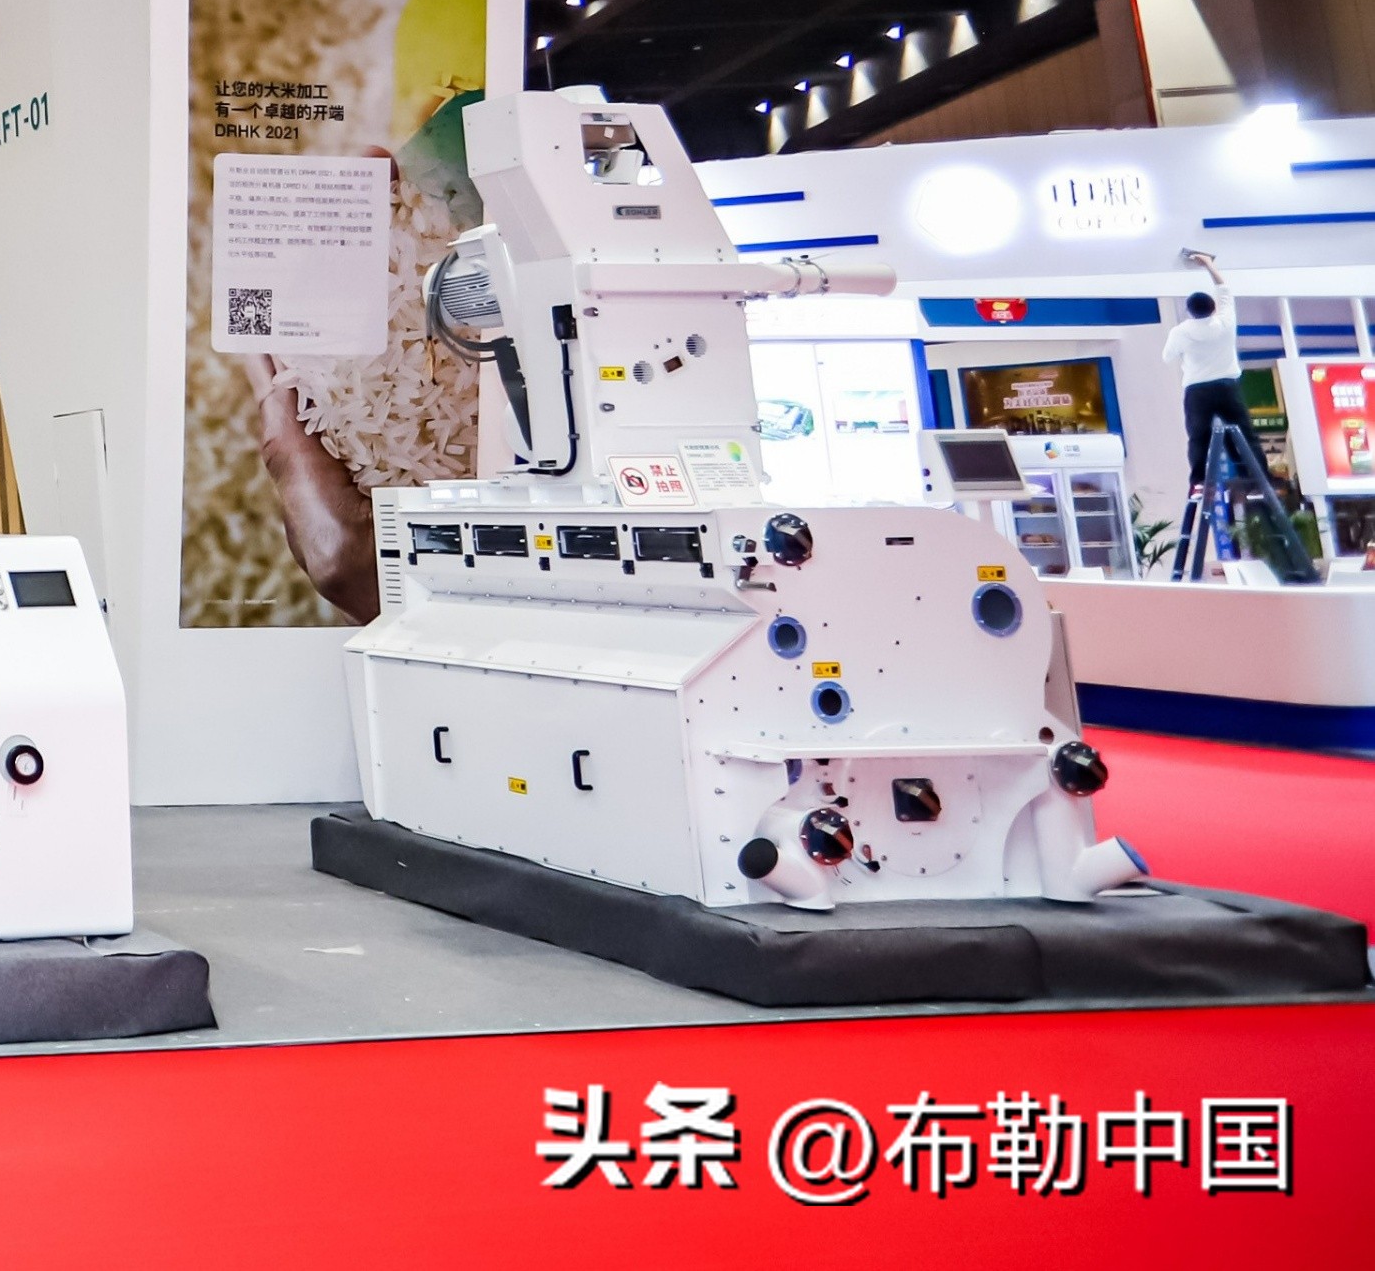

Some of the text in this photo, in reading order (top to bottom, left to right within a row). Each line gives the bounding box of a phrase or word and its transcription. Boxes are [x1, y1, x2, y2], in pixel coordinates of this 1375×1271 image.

[215, 80, 328, 99] 让您的大米加工
[215, 101, 344, 121] 有一个卓越的开端
[215, 124, 299, 139] DRHK 2021
[650, 464, 678, 477] 禁止
[655, 480, 684, 493] 拍照
